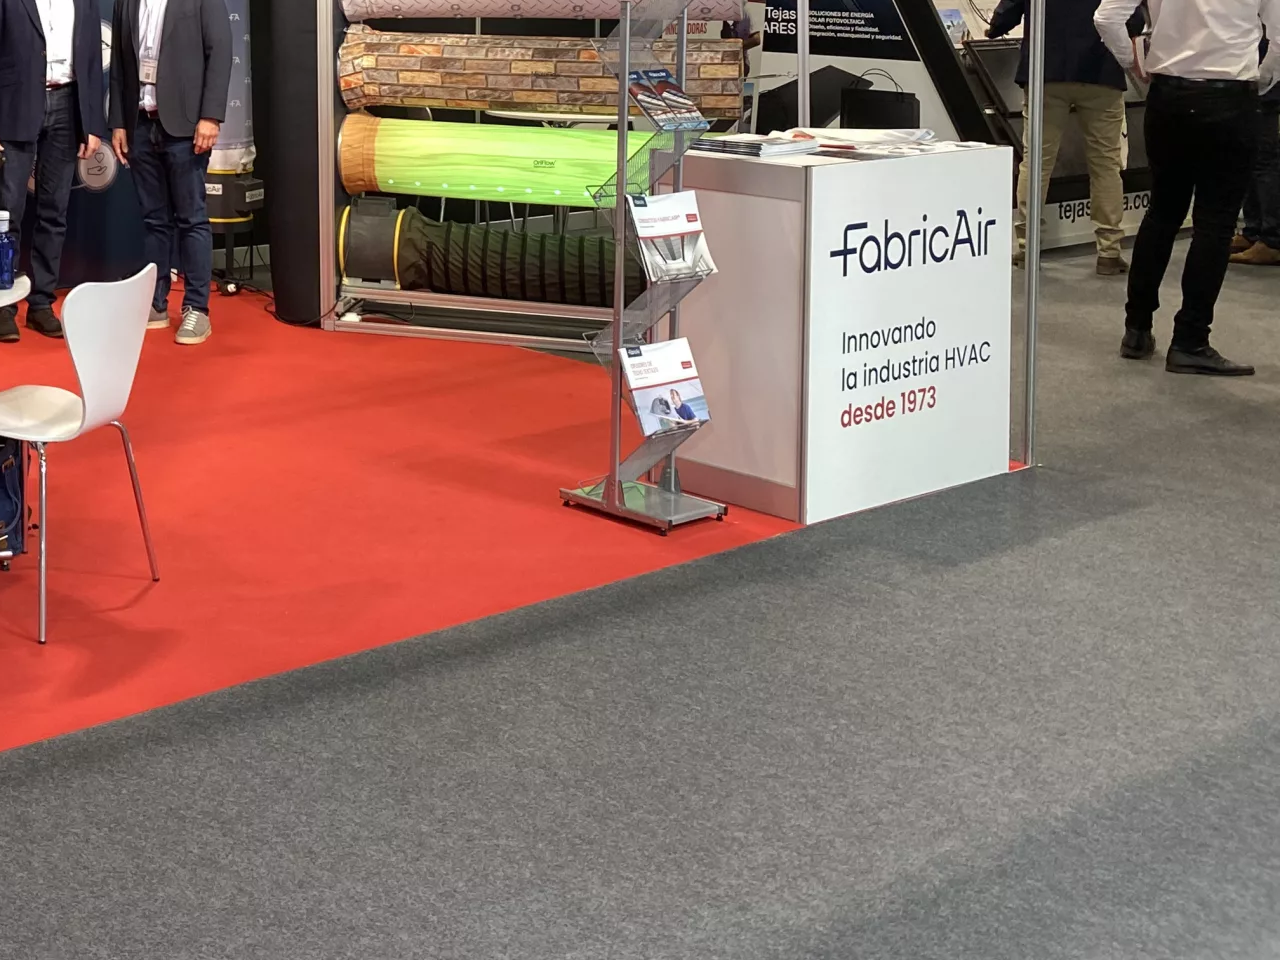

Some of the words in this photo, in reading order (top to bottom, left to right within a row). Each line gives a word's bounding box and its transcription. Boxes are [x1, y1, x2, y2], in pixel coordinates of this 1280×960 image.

[763, 22, 797, 35] ARES
[766, 6, 797, 21] Tejas
[808, 30, 837, 38] ntegración,
[830, 207, 996, 277] FabricAir
[841, 316, 937, 355] Innovando
[841, 367, 857, 392] la
[863, 351, 940, 387] industria
[944, 341, 992, 371] HVAC
[840, 396, 896, 429] desde
[900, 385, 937, 415] 1973
